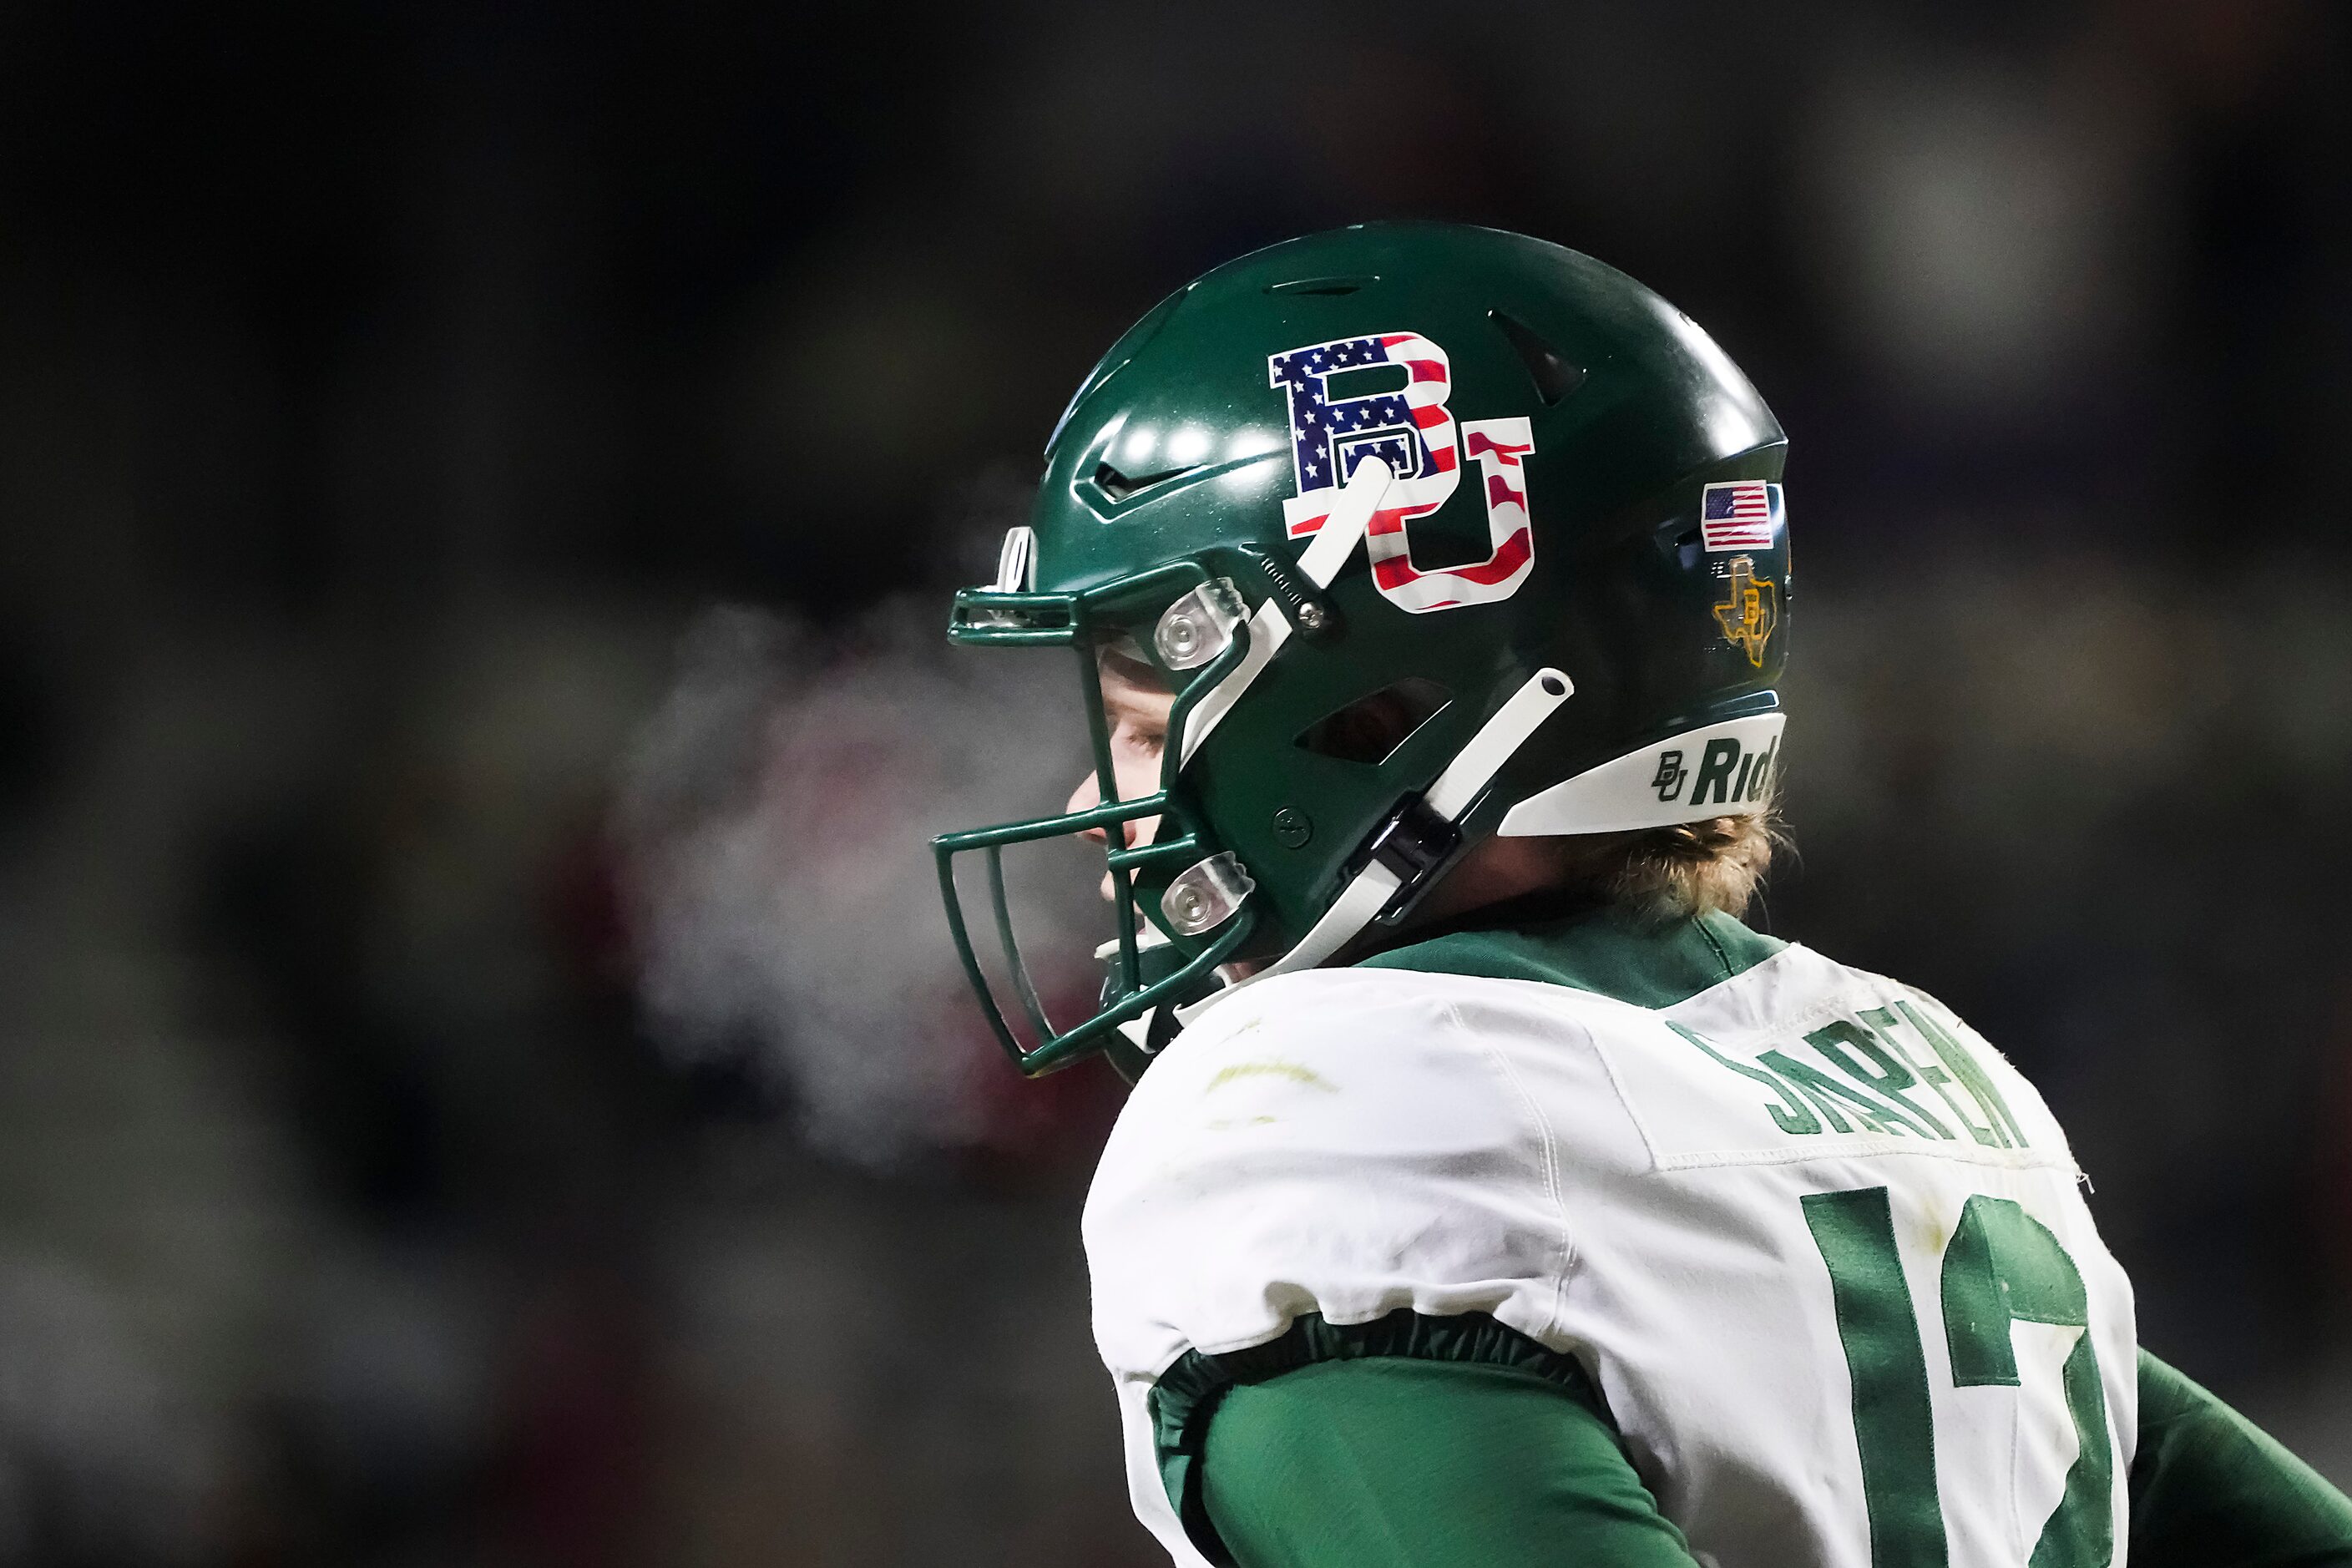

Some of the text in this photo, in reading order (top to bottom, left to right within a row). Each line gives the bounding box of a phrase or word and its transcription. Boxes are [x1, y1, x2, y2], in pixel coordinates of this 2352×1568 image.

[1267, 331, 1536, 614] BU
[1651, 750, 1689, 802] BU
[1800, 1186, 2114, 1568] 12
